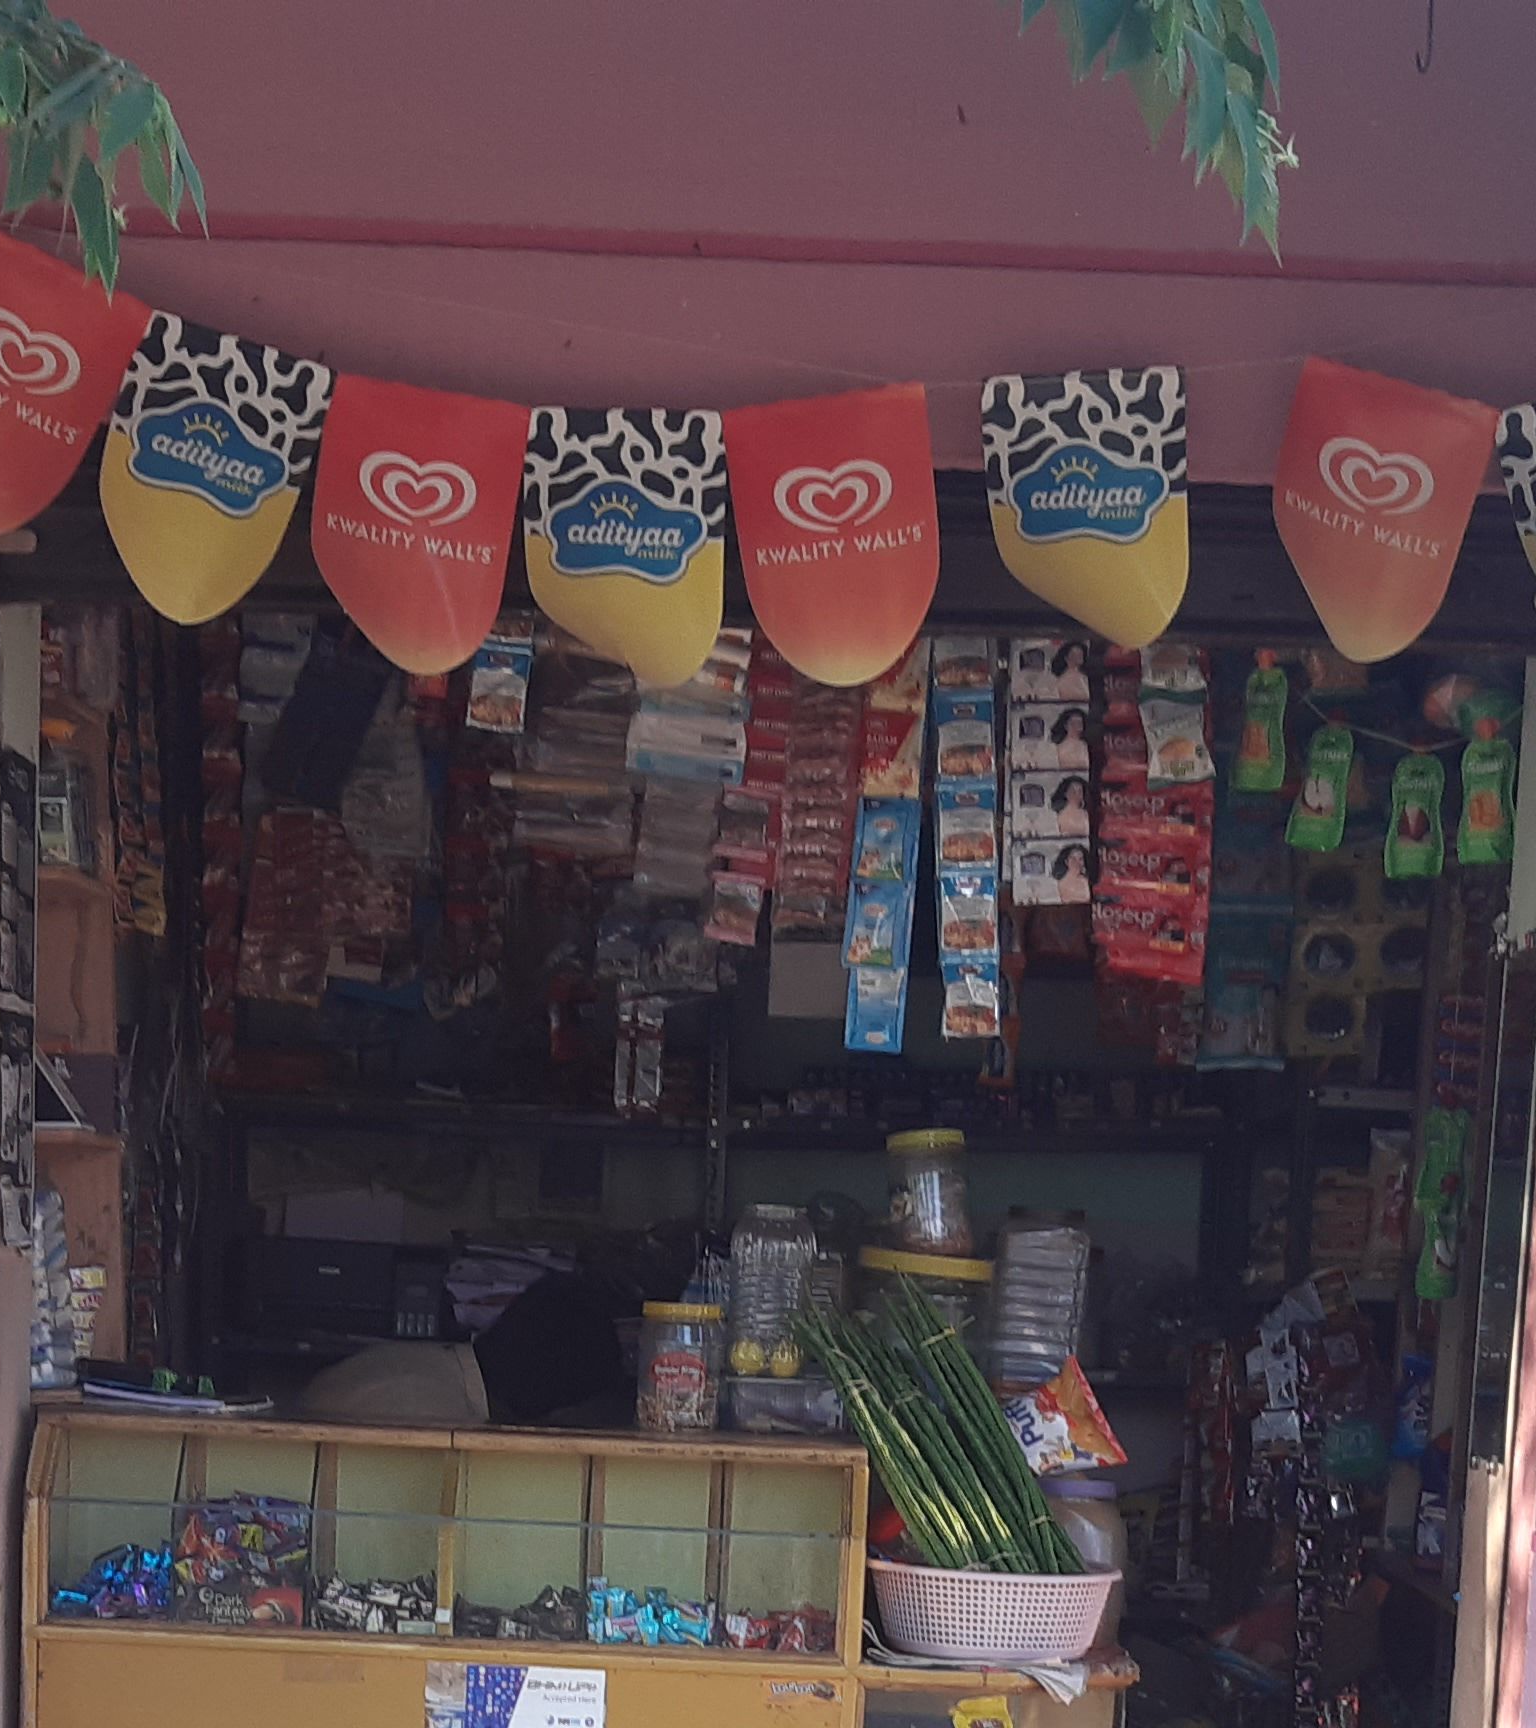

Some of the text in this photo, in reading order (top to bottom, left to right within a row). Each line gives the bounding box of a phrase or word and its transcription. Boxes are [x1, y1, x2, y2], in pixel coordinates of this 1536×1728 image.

[16, 400, 79, 446] WALL'S
[151, 432, 266, 485] adityaa
[1030, 481, 1146, 520] adityaa
[1284, 487, 1441, 559] KWALITY WALL'S
[326, 512, 494, 566] KWALITY WALL'S
[567, 518, 685, 558] adityaa
[755, 524, 924, 568] KWALITY WALL'S
